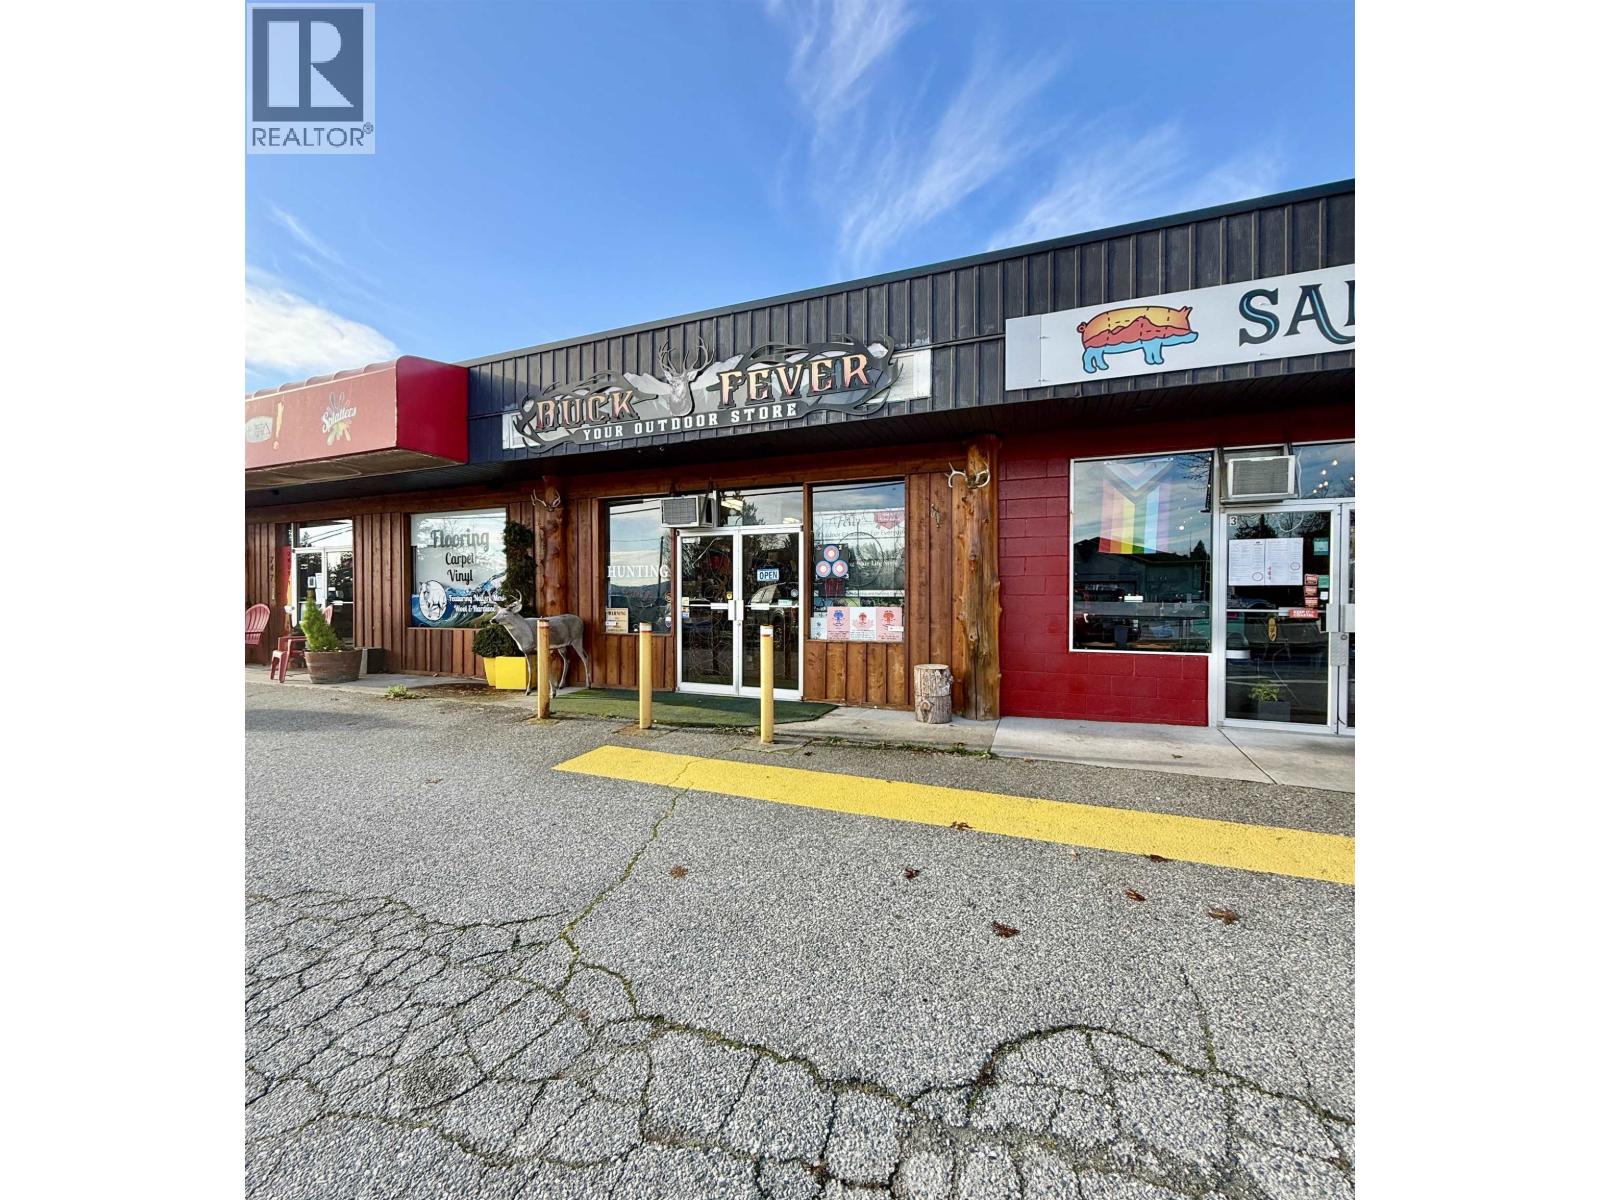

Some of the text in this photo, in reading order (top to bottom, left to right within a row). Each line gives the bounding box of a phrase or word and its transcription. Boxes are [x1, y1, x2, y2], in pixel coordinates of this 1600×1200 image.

[536, 353, 870, 434] BUCK FEVER
[583, 402, 797, 441] YOUR OUTDOOR STORE
[1230, 516, 1237, 526] 3
[430, 528, 490, 552] Flooring
[445, 552, 475, 567] Carpet
[447, 569, 473, 585] Vinyl
[607, 565, 669, 578] HUNTING
[760, 572, 778, 580] OPEN
